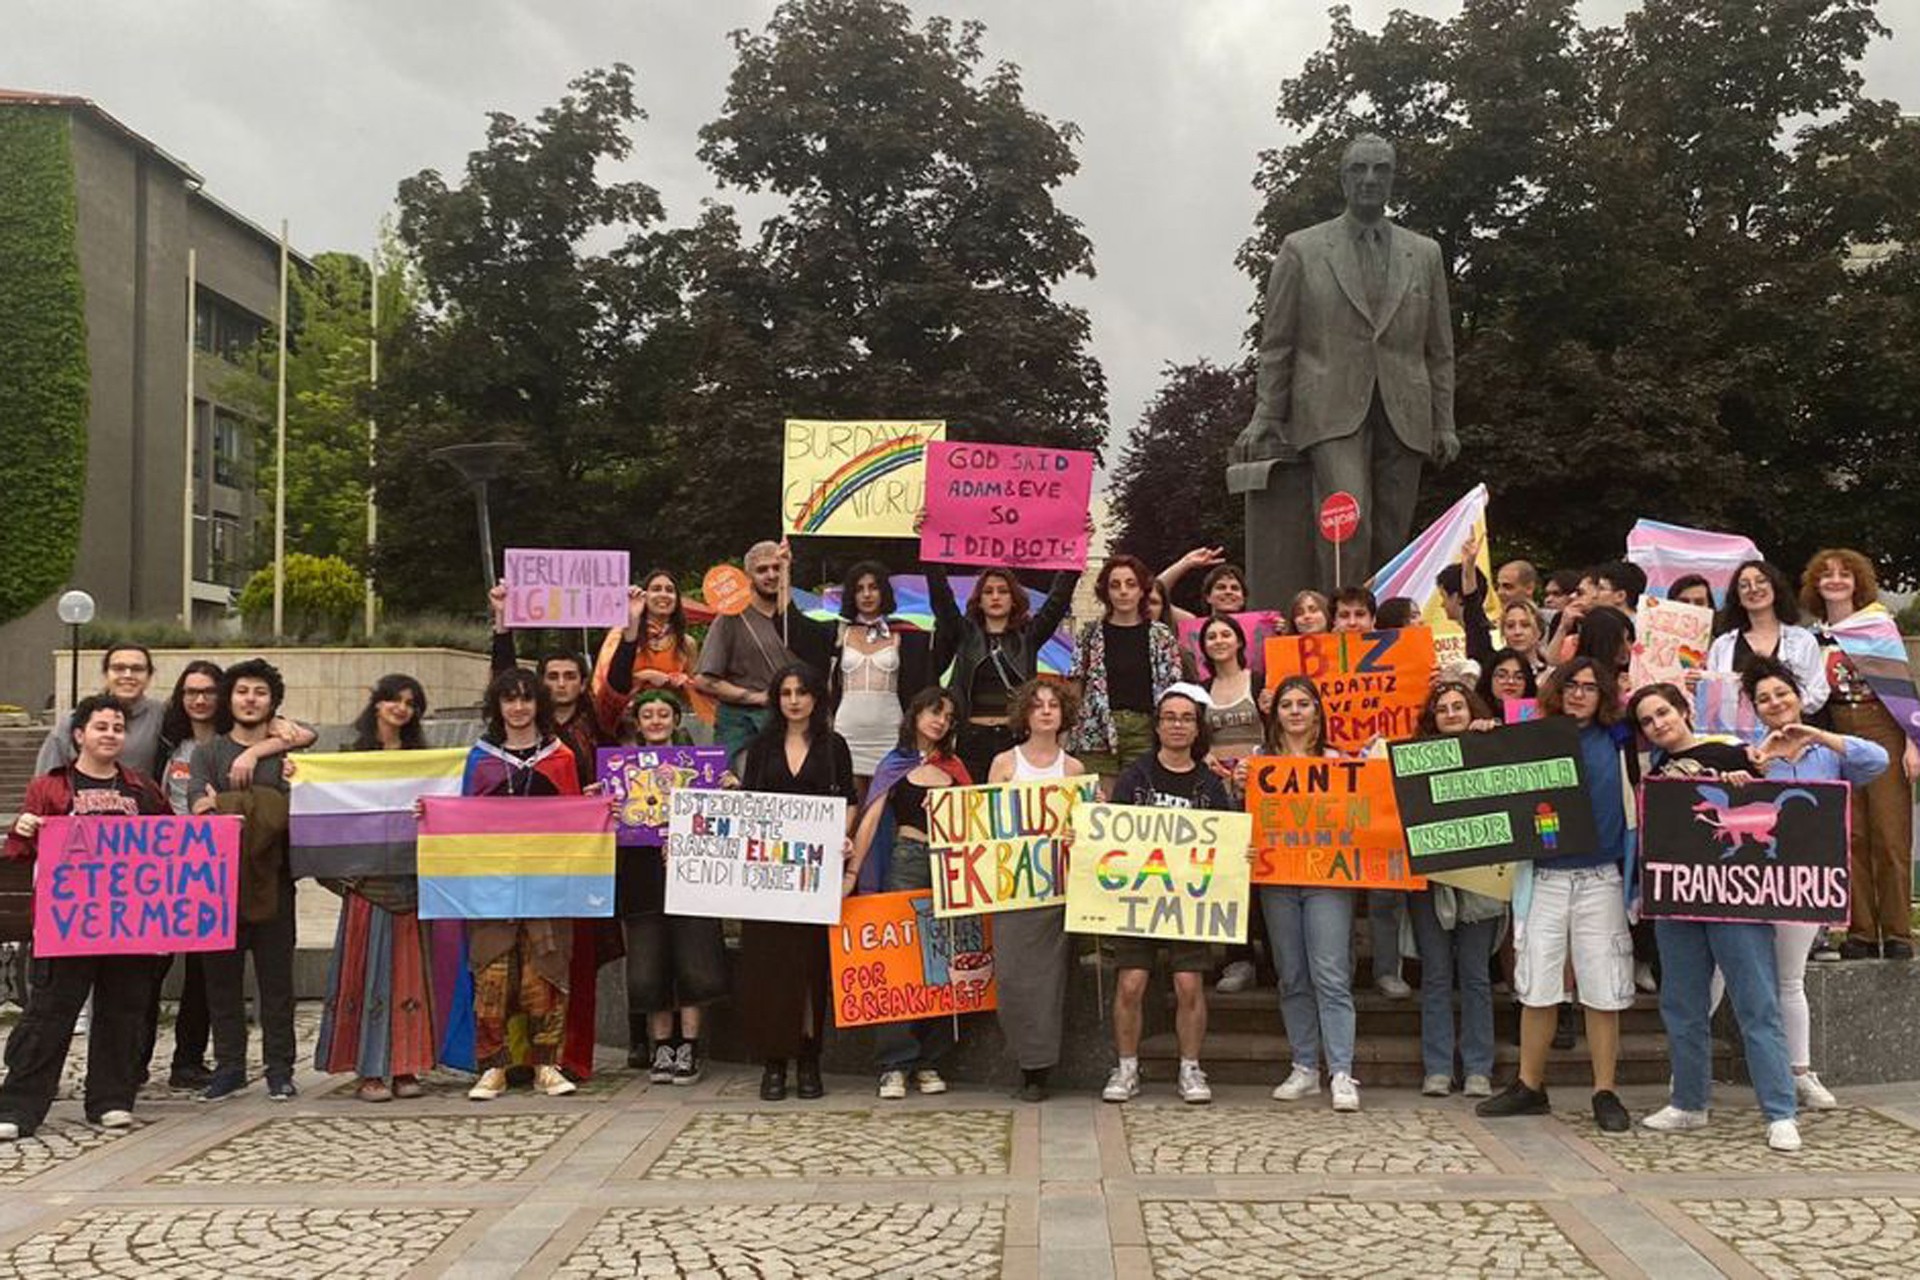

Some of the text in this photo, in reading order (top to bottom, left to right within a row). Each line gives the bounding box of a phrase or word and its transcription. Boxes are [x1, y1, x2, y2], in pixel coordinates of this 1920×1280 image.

[947, 447, 1069, 471] GOD SAID
[948, 480, 1062, 498] ADAM&EVE
[988, 506, 1019, 525] SO
[939, 533, 956, 557] I
[965, 536, 1005, 557] DID
[1319, 676, 1396, 696] RDAYIZ
[1258, 762, 1366, 793] CAN'T
[692, 814, 730, 837] BEN
[1088, 806, 1220, 845] SOUNDS
[1261, 797, 1371, 833] EVEN
[63, 818, 217, 862] ANNEM
[746, 838, 824, 867] ELALEM
[930, 838, 1071, 910] TEK BAŞIN
[1096, 847, 1216, 898] GAY
[1254, 847, 1405, 881] SRAIGH
[1646, 862, 1848, 908] TRANSSAURUS
[841, 925, 852, 954] I
[860, 919, 915, 950] EAT
[841, 961, 886, 994] FOR
[841, 980, 985, 1022] BREAKFAST
